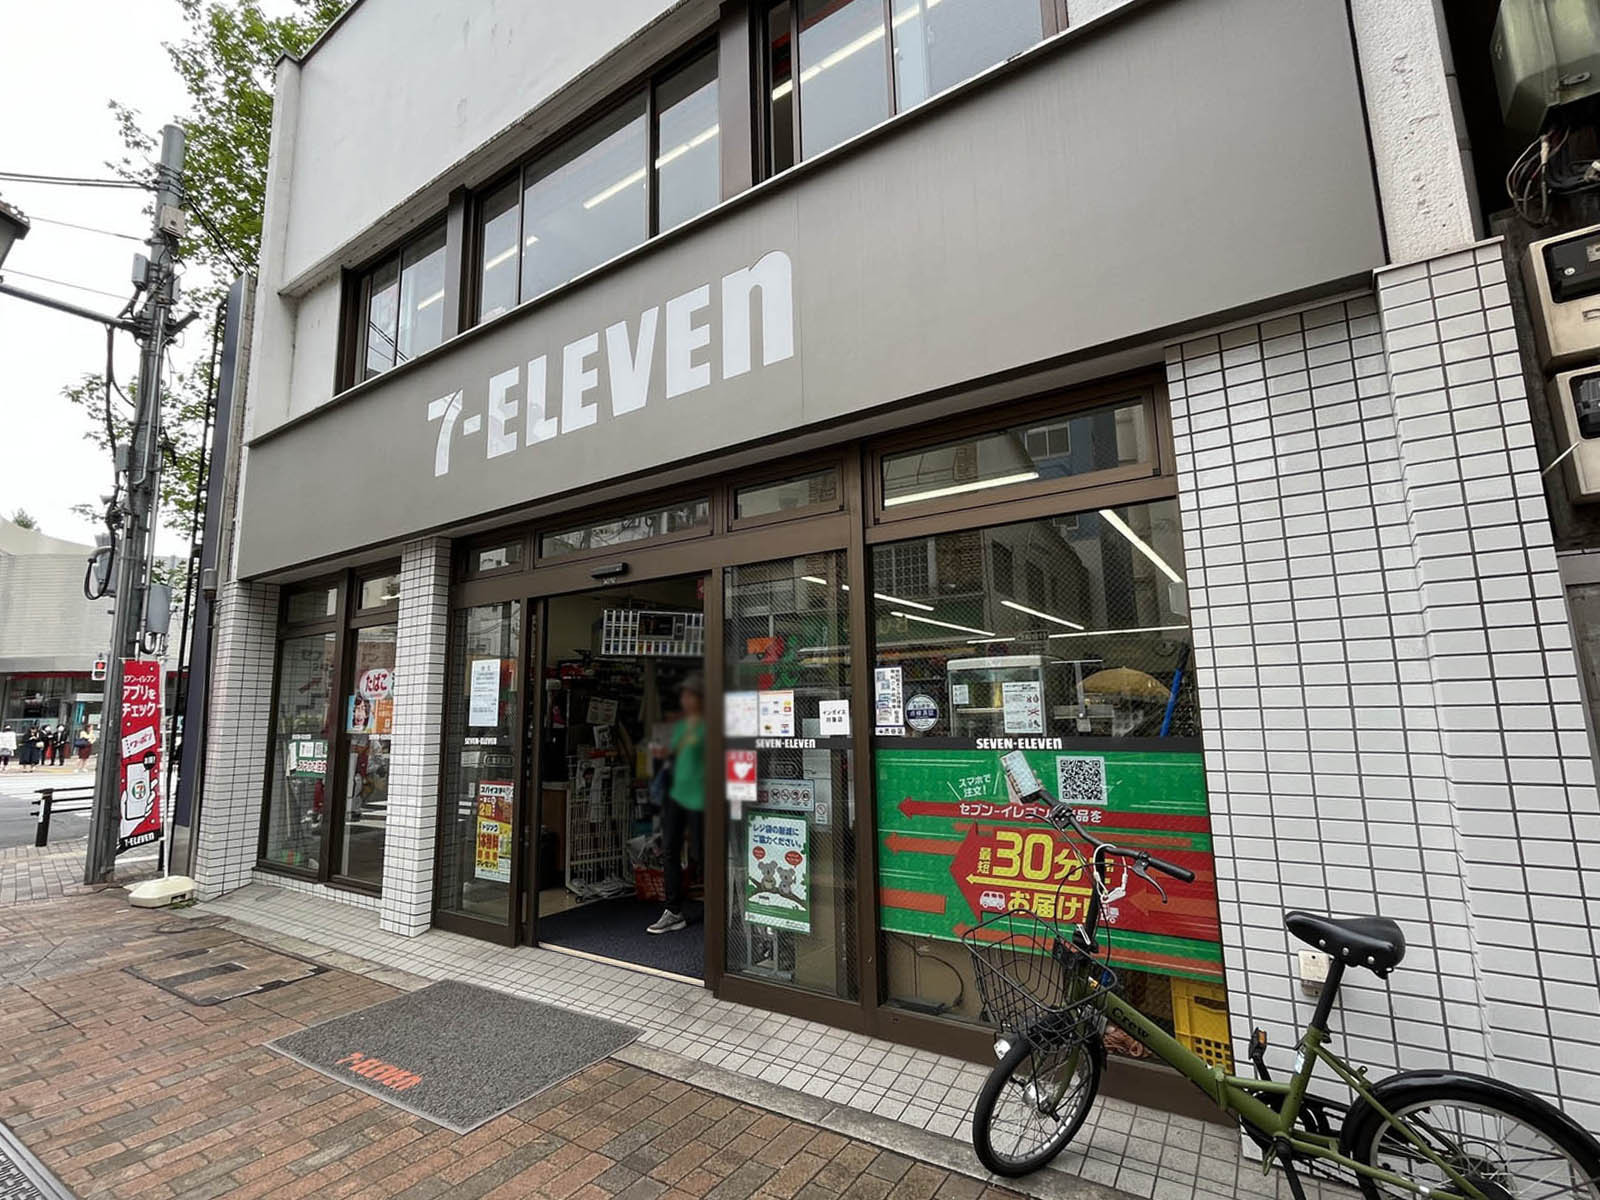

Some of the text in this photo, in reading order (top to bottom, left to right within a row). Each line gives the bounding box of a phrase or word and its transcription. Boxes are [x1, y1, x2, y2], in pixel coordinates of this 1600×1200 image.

[122, 685, 156, 700] アプリを
[122, 702, 156, 717] チェック
[958, 774, 992, 789] スマホで
